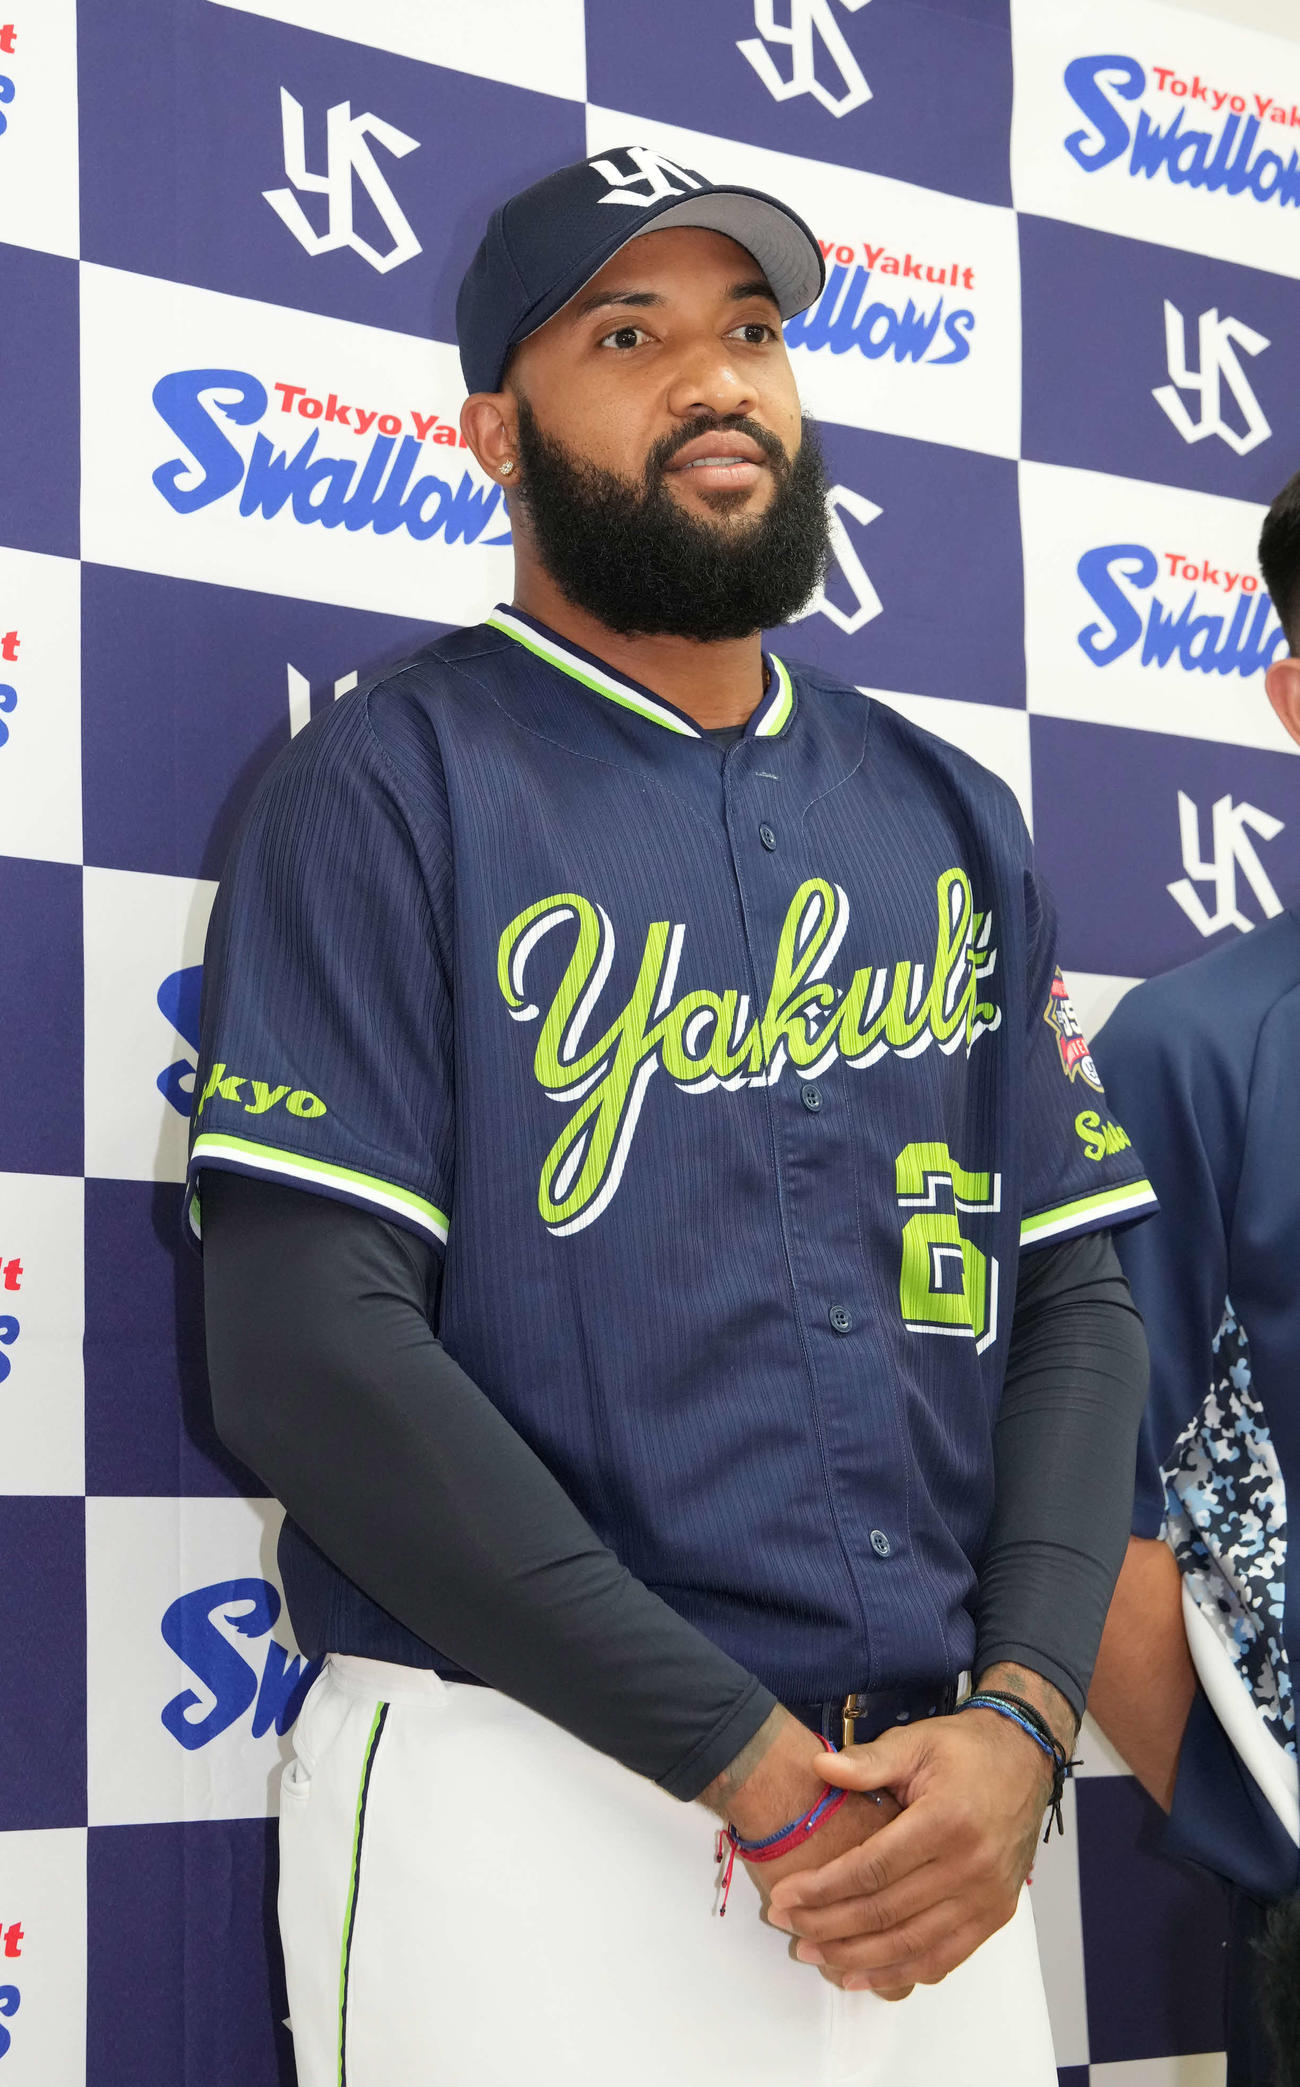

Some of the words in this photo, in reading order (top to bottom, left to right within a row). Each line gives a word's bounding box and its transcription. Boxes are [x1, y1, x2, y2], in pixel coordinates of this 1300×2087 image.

[1152, 66, 1246, 113] Tokyo
[1254, 93, 1300, 129] Yak
[863, 243, 975, 290] Yakult
[274, 382, 403, 436] Tokyo
[151, 368, 515, 546] Swallow
[1164, 553, 1259, 593] Tokyo
[497, 867, 1002, 1237] Yakult
[198, 1063, 328, 1119] kyo
